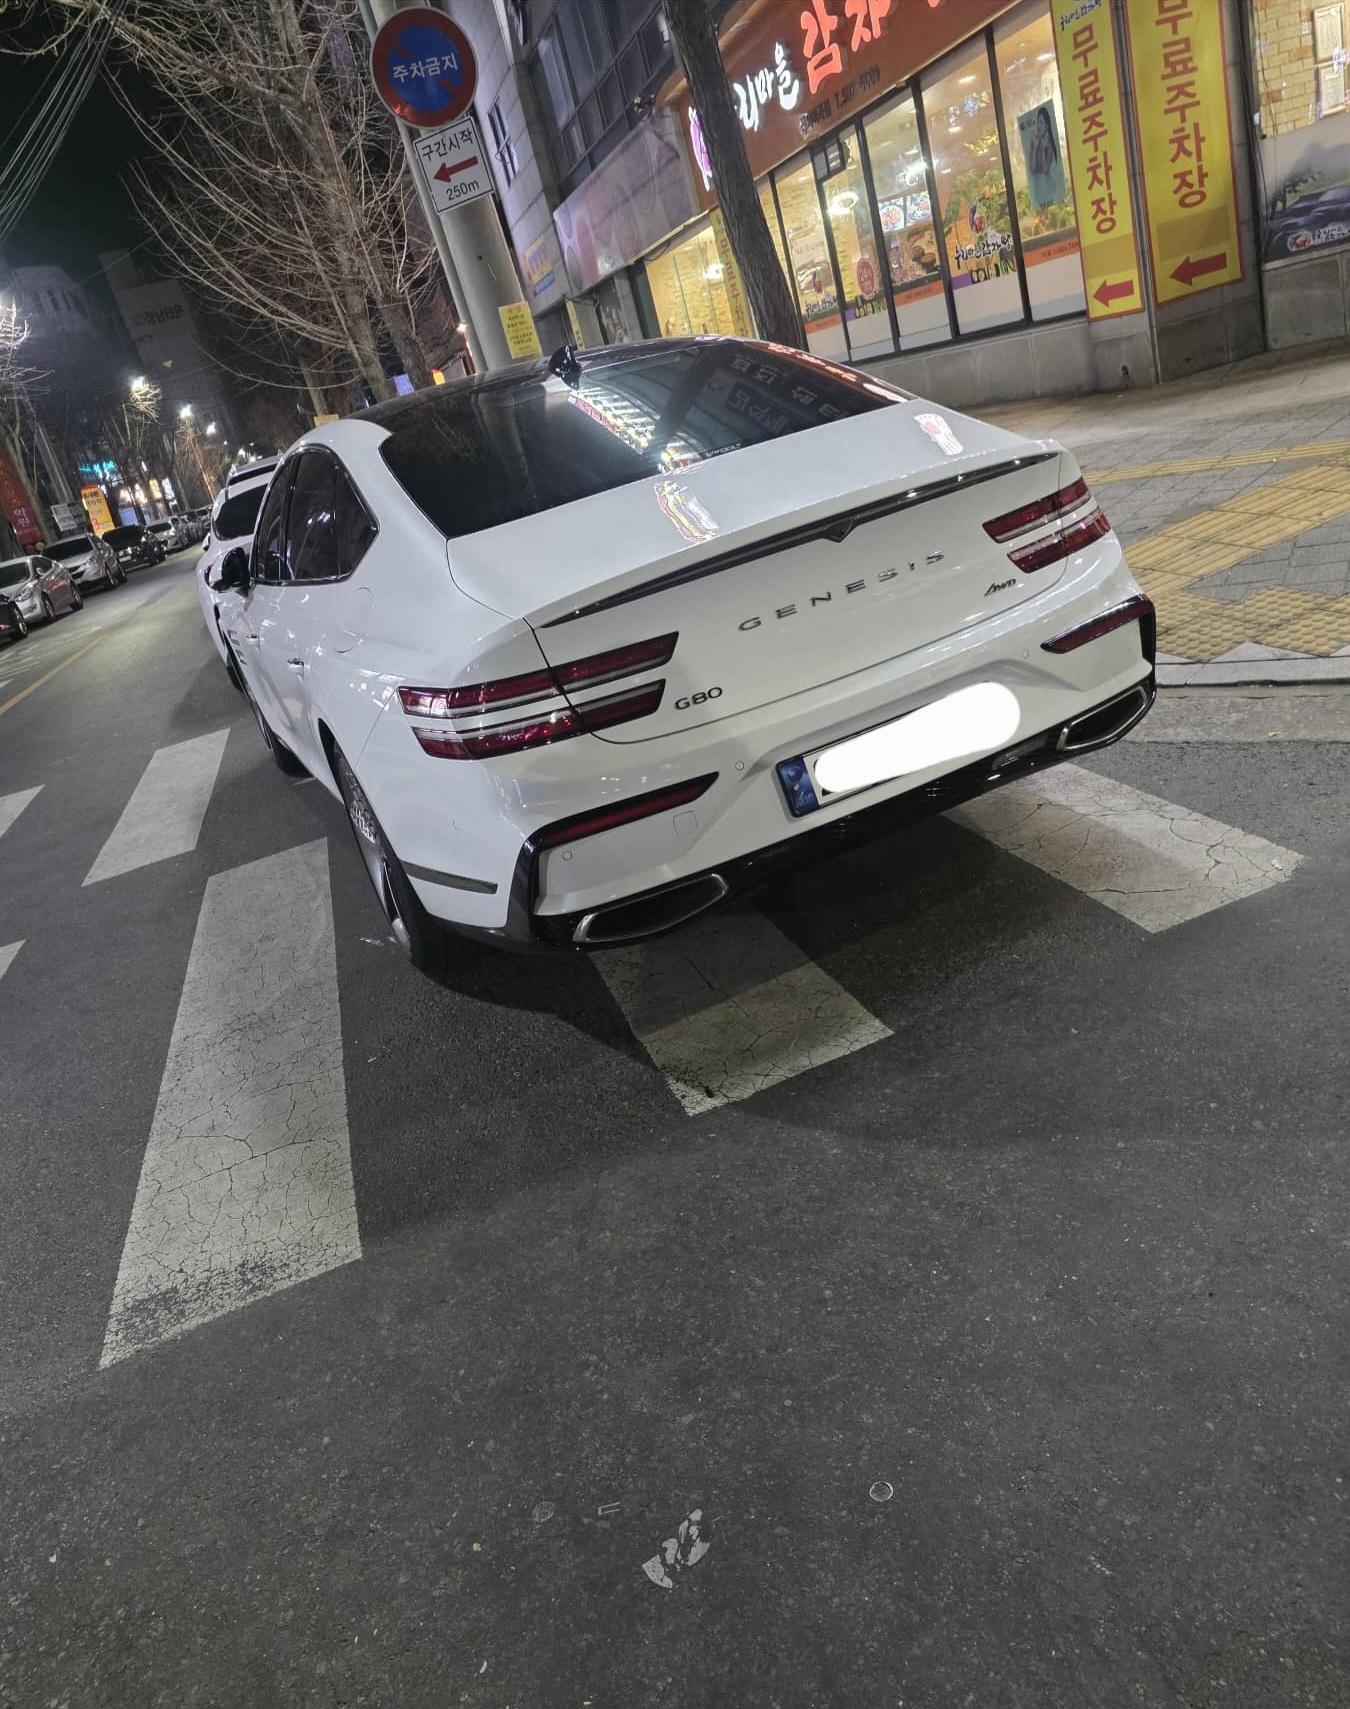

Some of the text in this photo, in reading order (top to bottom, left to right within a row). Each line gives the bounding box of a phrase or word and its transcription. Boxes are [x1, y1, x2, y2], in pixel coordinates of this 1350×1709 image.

[393, 52, 458, 83] 주차금지
[734, 41, 799, 132] 리마을
[801, 0, 940, 94] 감자
[1072, 23, 1117, 234] 무료주차장
[1155, 0, 1209, 209] 무료주차장
[421, 127, 474, 162] 구간시작
[446, 179, 480, 201] 250m
[738, 551, 945, 631] GENESIS
[675, 686, 723, 710] G80
